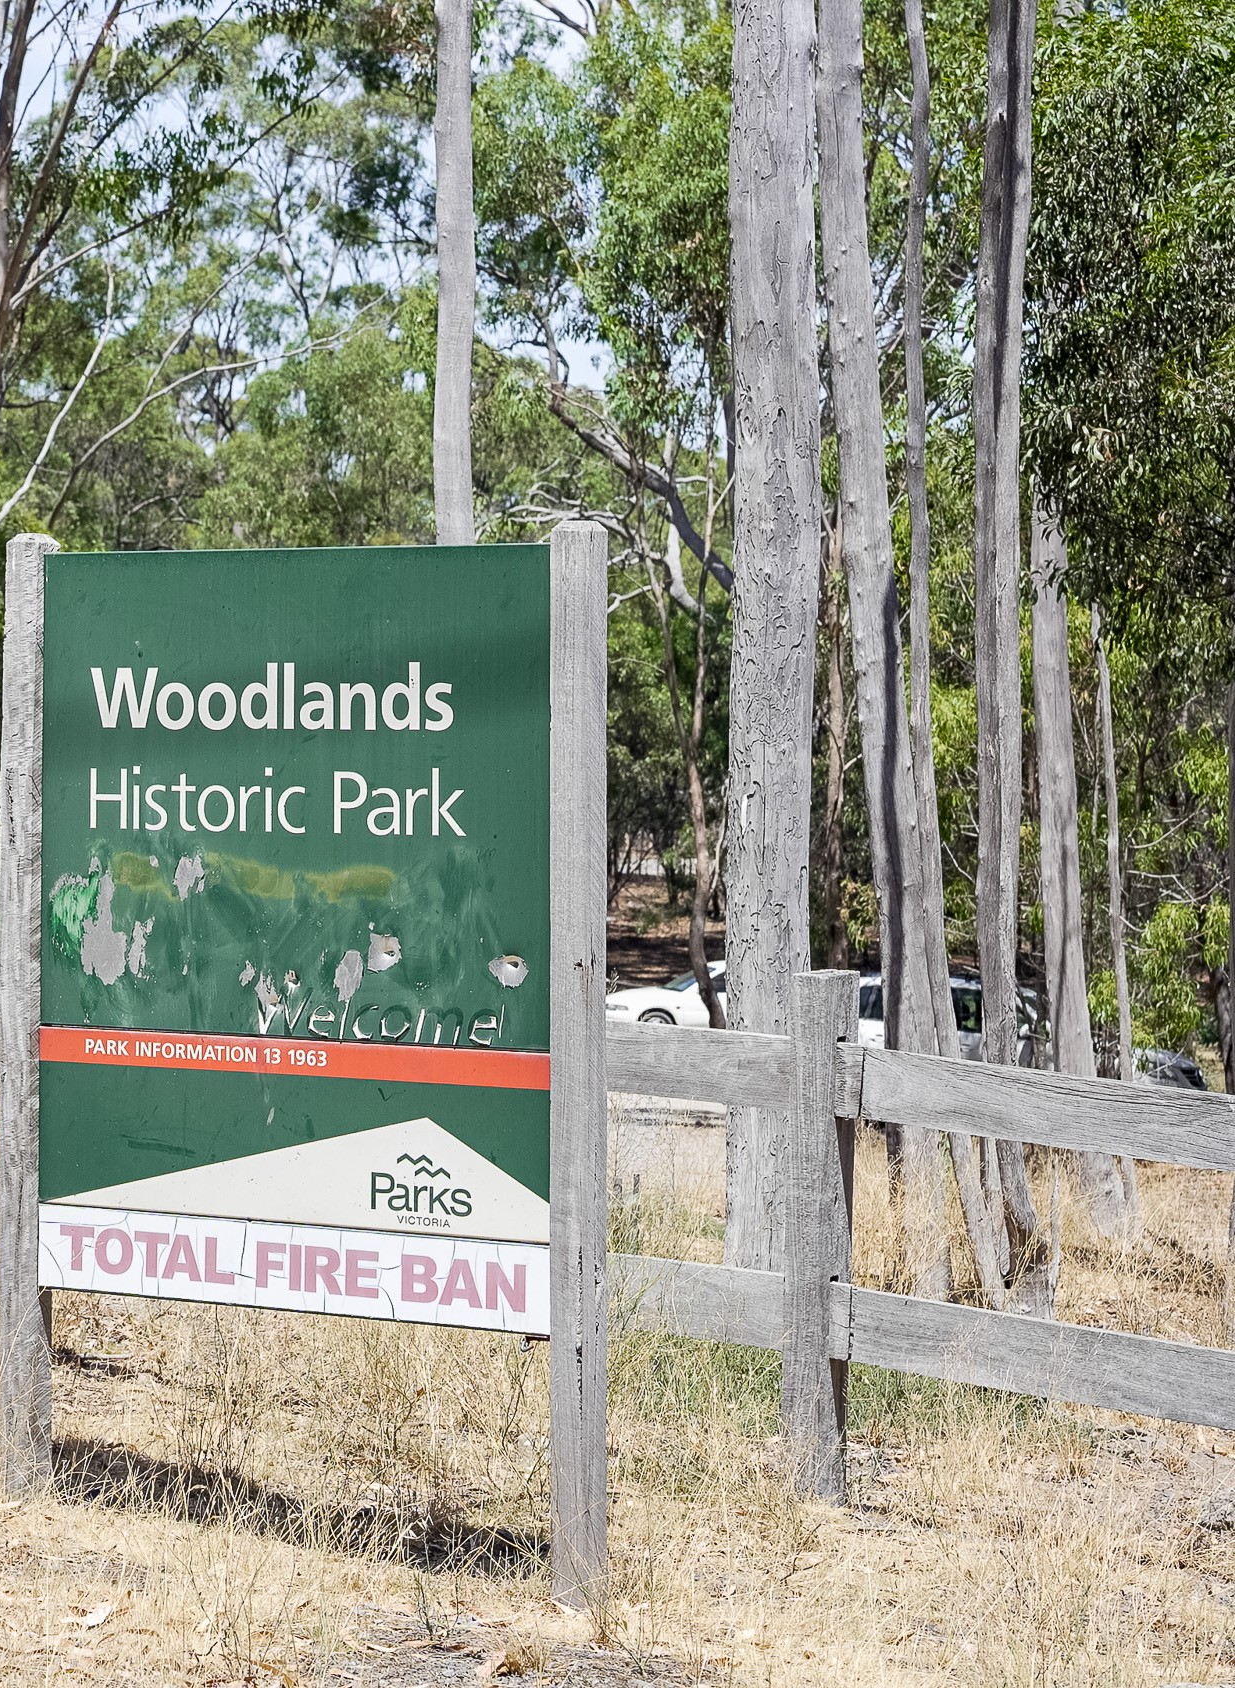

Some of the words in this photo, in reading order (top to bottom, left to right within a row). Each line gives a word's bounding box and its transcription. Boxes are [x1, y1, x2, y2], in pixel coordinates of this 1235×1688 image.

[90, 661, 454, 732] Woodlands
[88, 766, 307, 834] Historic
[332, 767, 467, 837] Park
[84, 1038, 129, 1056] PARK
[134, 1041, 257, 1064] INFORMATION
[264, 1048, 282, 1065] 13
[287, 1049, 328, 1068] 1963
[370, 1171, 473, 1217] Parks
[396, 1214, 451, 1229] VICTORIA
[59, 1224, 235, 1286] TOTAL
[255, 1242, 380, 1299] FIRE
[400, 1254, 527, 1313] BAN
